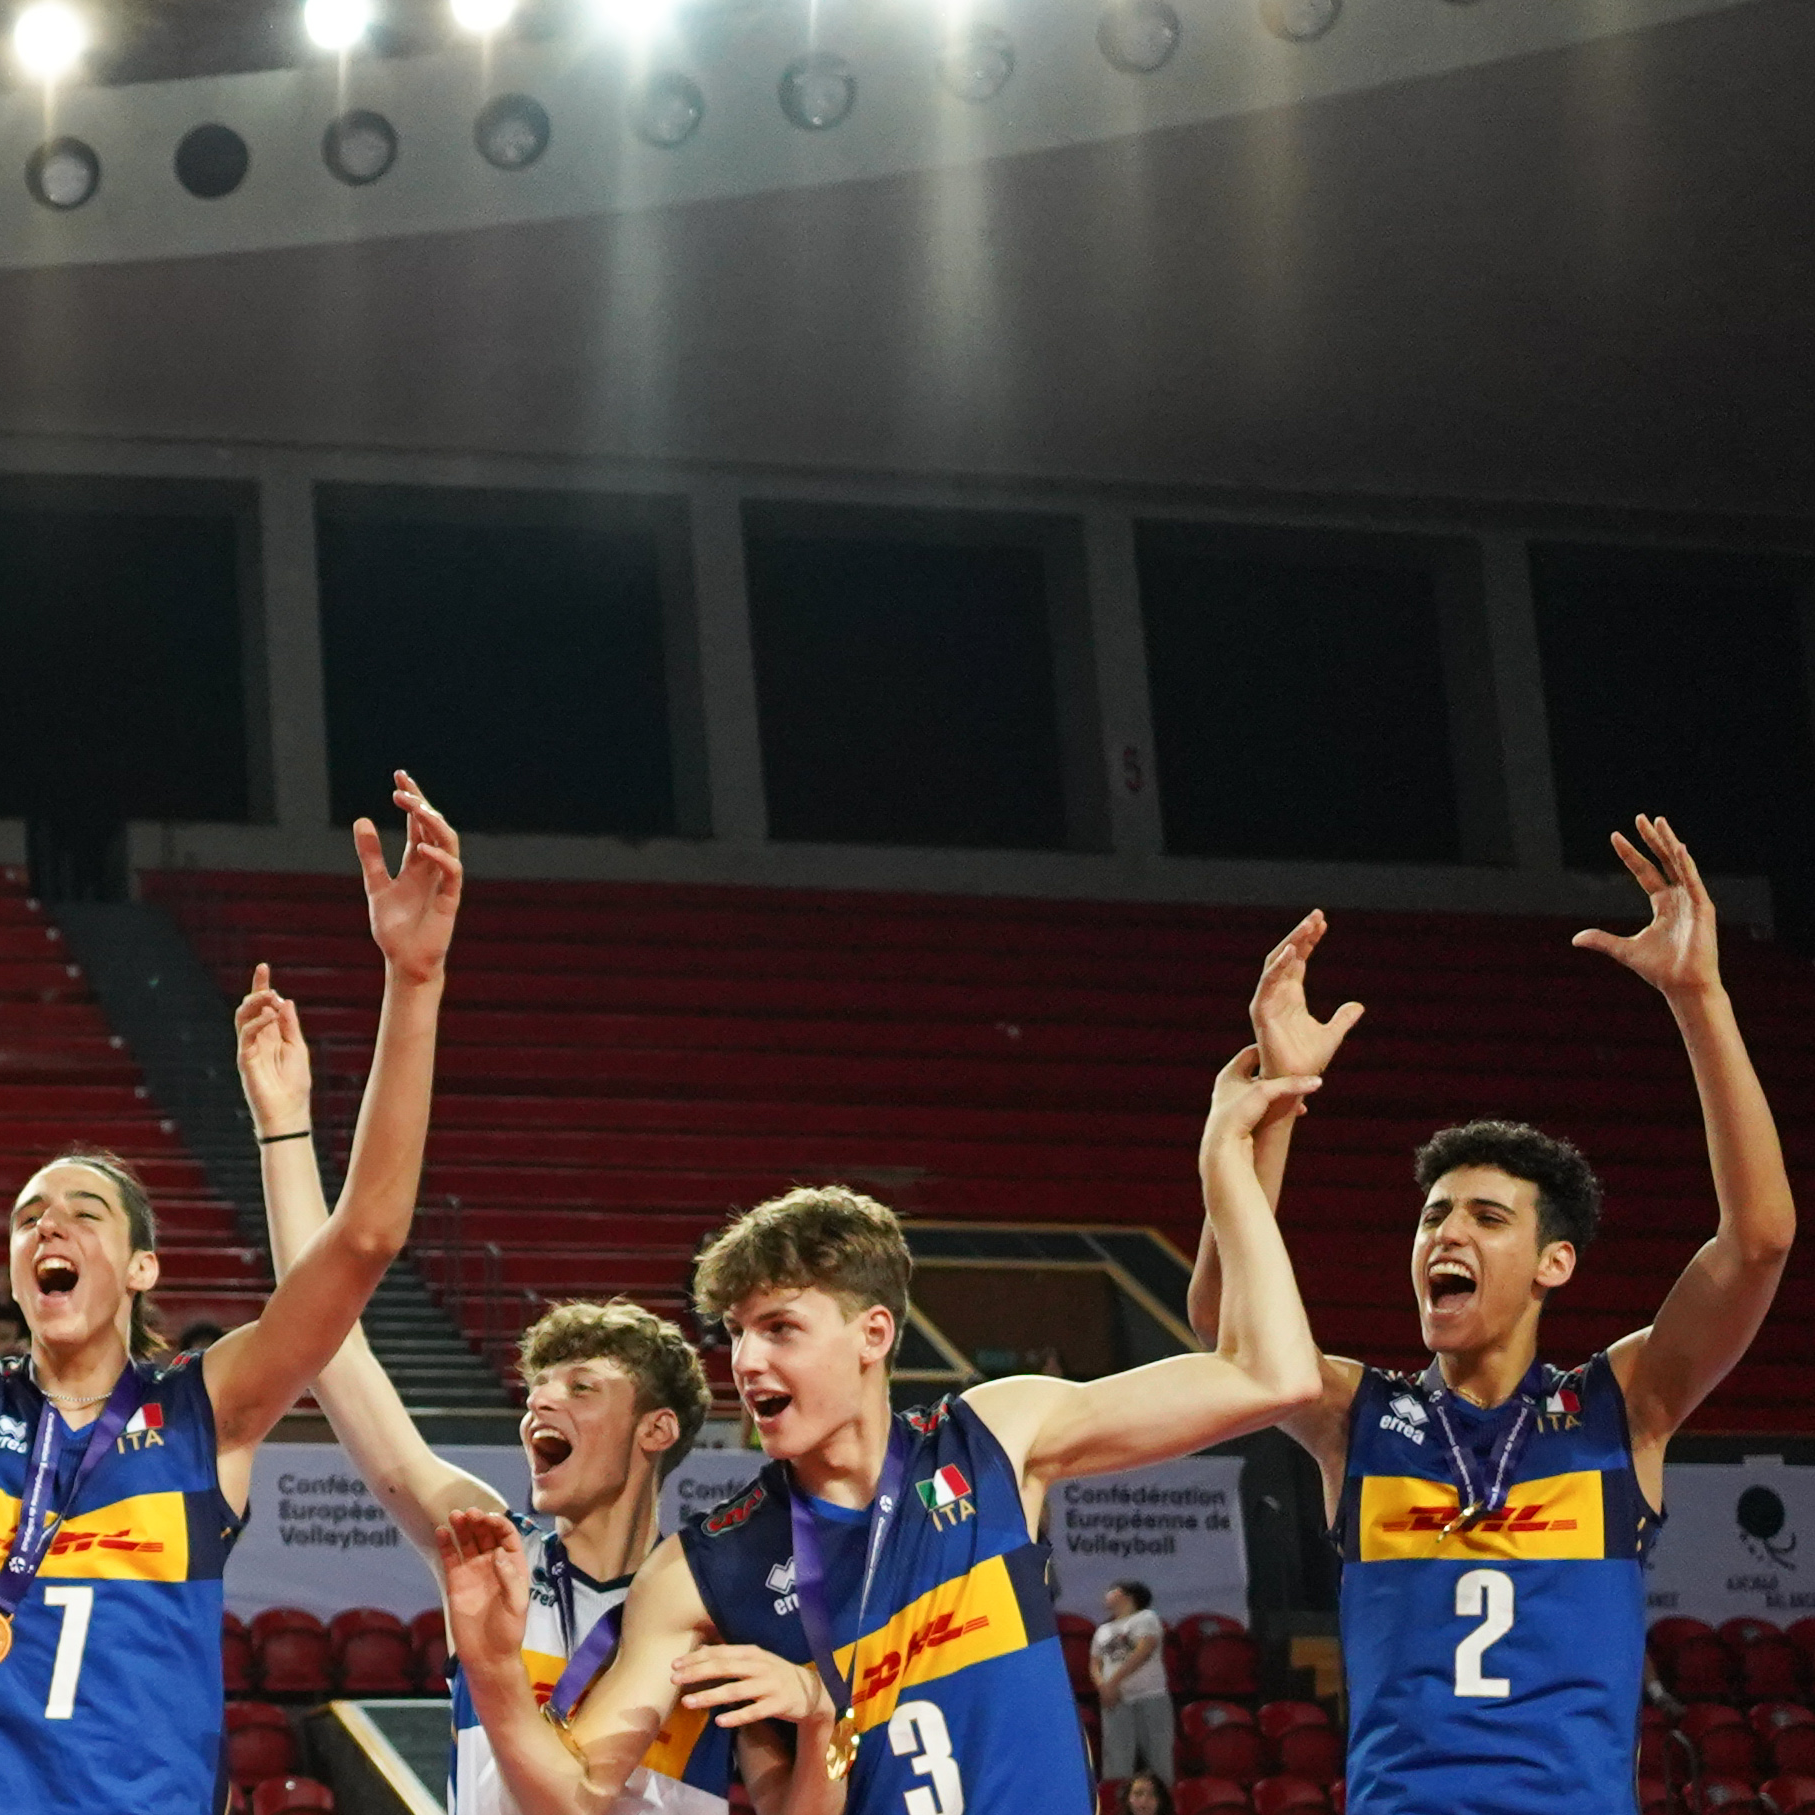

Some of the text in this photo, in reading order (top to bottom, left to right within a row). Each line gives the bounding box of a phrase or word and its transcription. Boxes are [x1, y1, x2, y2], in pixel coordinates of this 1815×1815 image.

[116, 1429, 164, 1454] ITA
[1537, 1413, 1583, 1434] ITA
[930, 1499, 976, 1532] ITA
[43, 1586, 97, 1720] 7
[861, 1611, 967, 1698] DHL
[1453, 1568, 1515, 1698] 2
